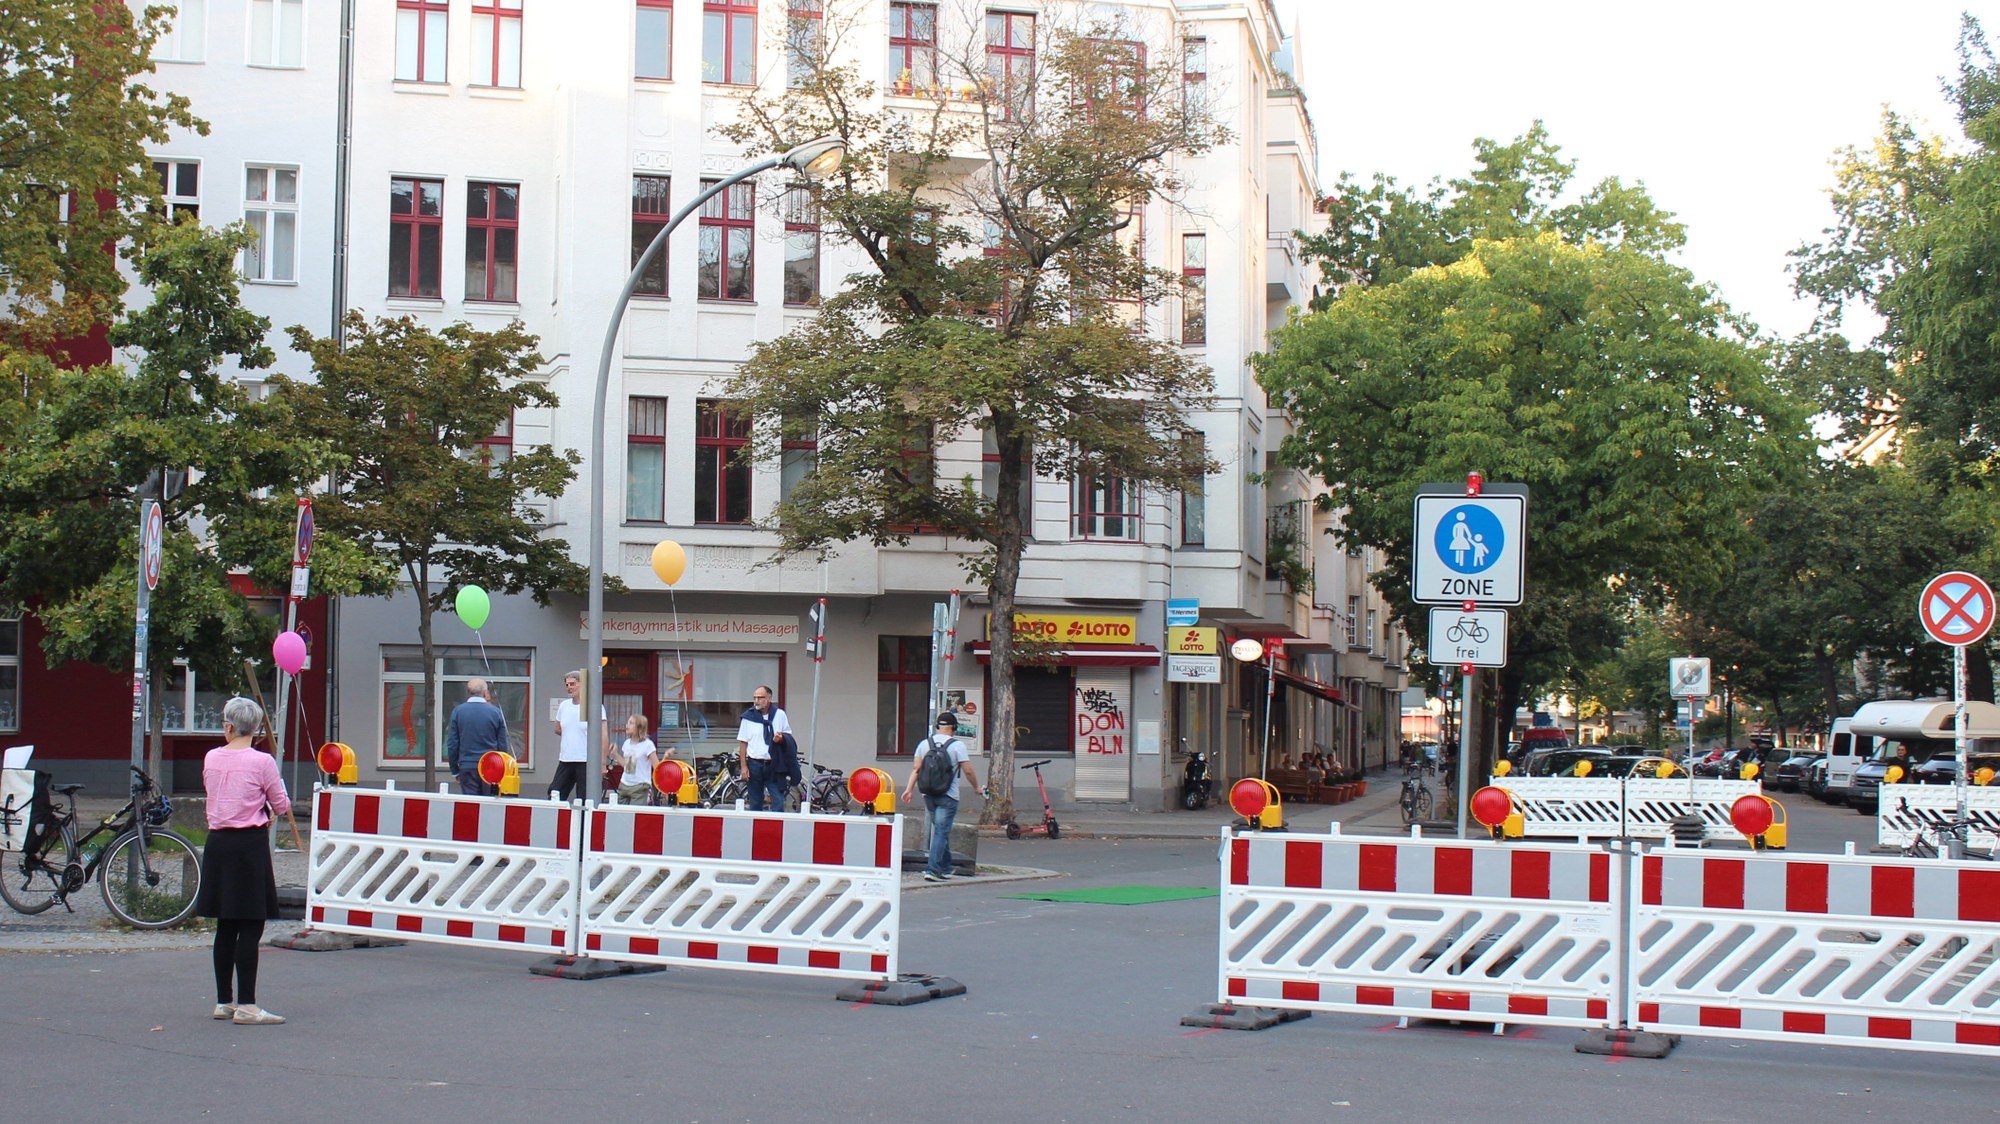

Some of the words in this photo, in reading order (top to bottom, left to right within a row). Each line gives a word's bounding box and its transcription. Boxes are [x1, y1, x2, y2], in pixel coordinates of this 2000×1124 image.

[1441, 578, 1494, 596] ZONE
[579, 617, 702, 635] Knkengymnastik
[705, 620, 729, 633] und
[732, 620, 799, 637] Massagen
[1086, 623, 1131, 637] LOTTO
[1180, 643, 1205, 652] LOTTO
[1456, 646, 1479, 659] frei
[1172, 664, 1217, 673] TAGESSPIEGEL
[1078, 710, 1125, 737] DON
[1088, 734, 1123, 755] BLN
